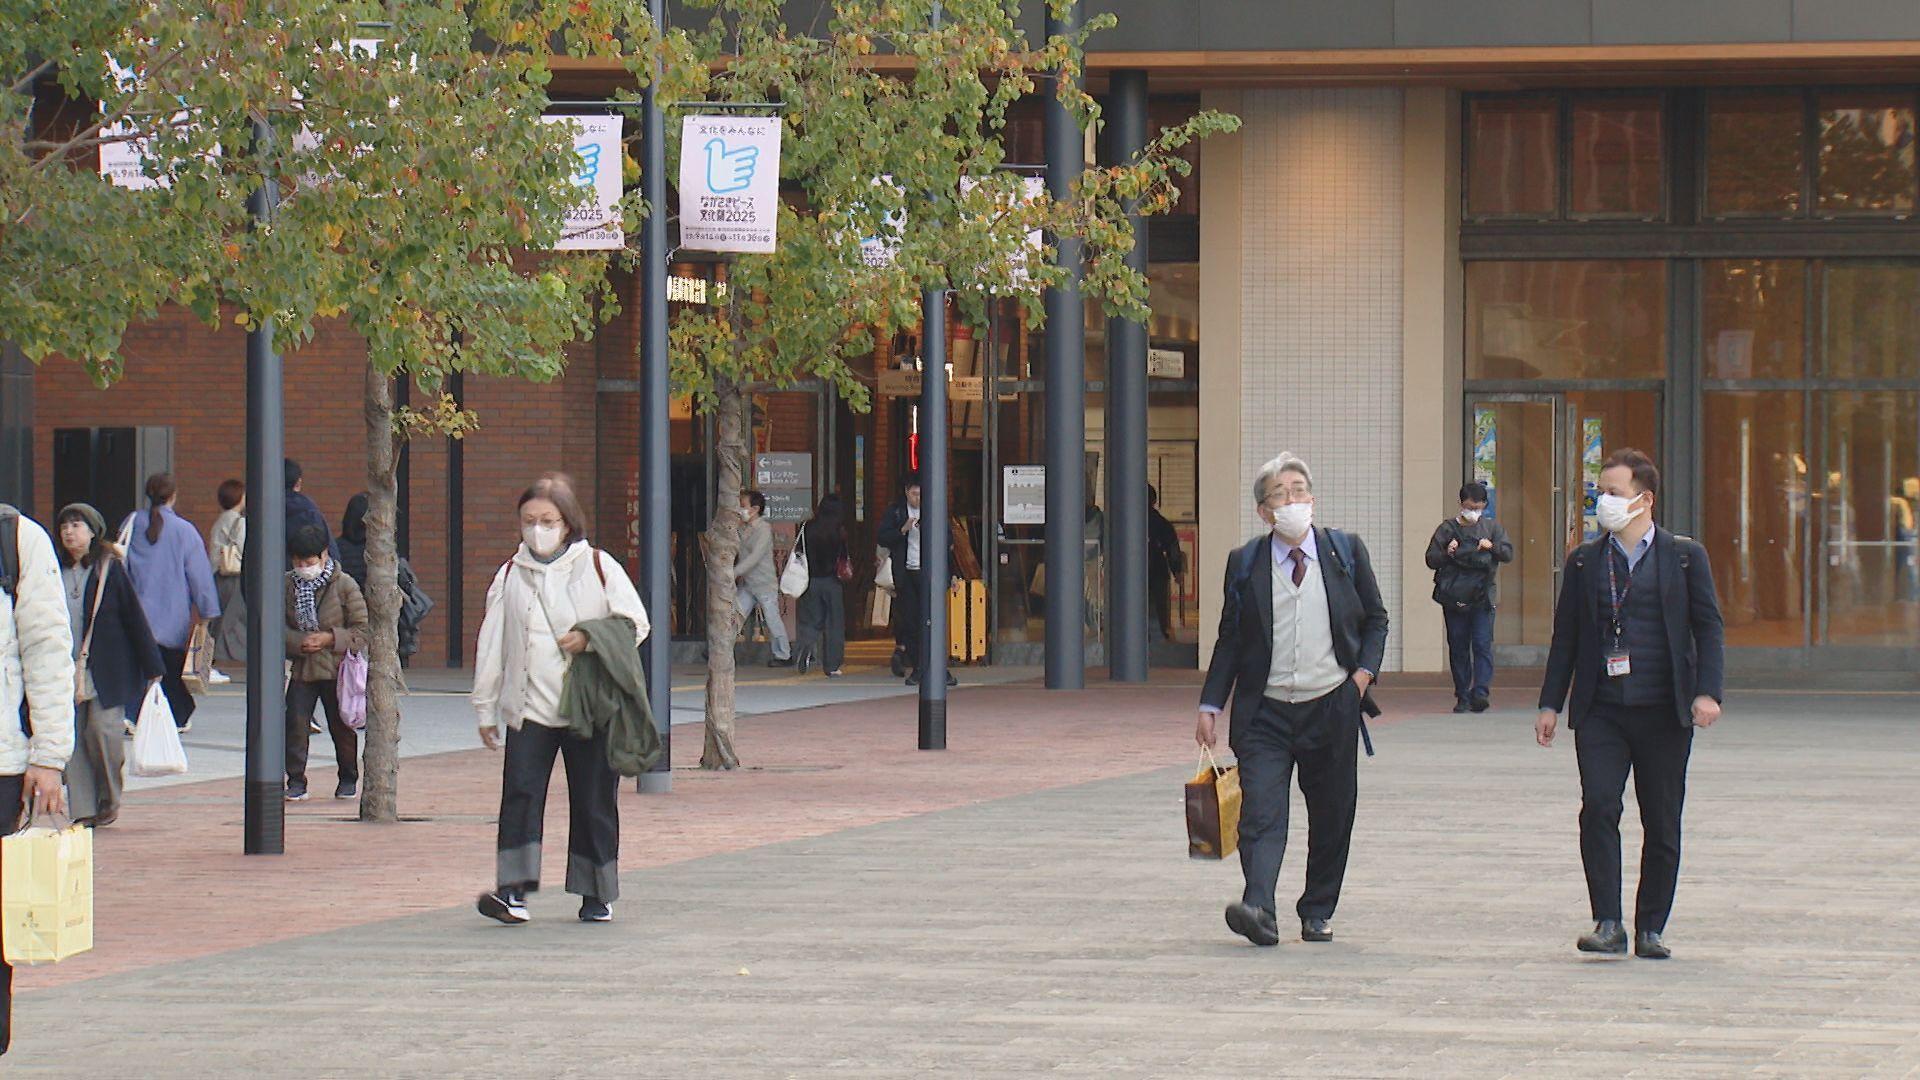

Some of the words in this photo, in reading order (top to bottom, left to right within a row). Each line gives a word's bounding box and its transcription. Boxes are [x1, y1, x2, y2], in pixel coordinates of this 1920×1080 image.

[699, 125, 766, 136] 文化をみんなに
[700, 195, 754, 209] ながさきピース
[699, 209, 756, 222] 文化祭2025
